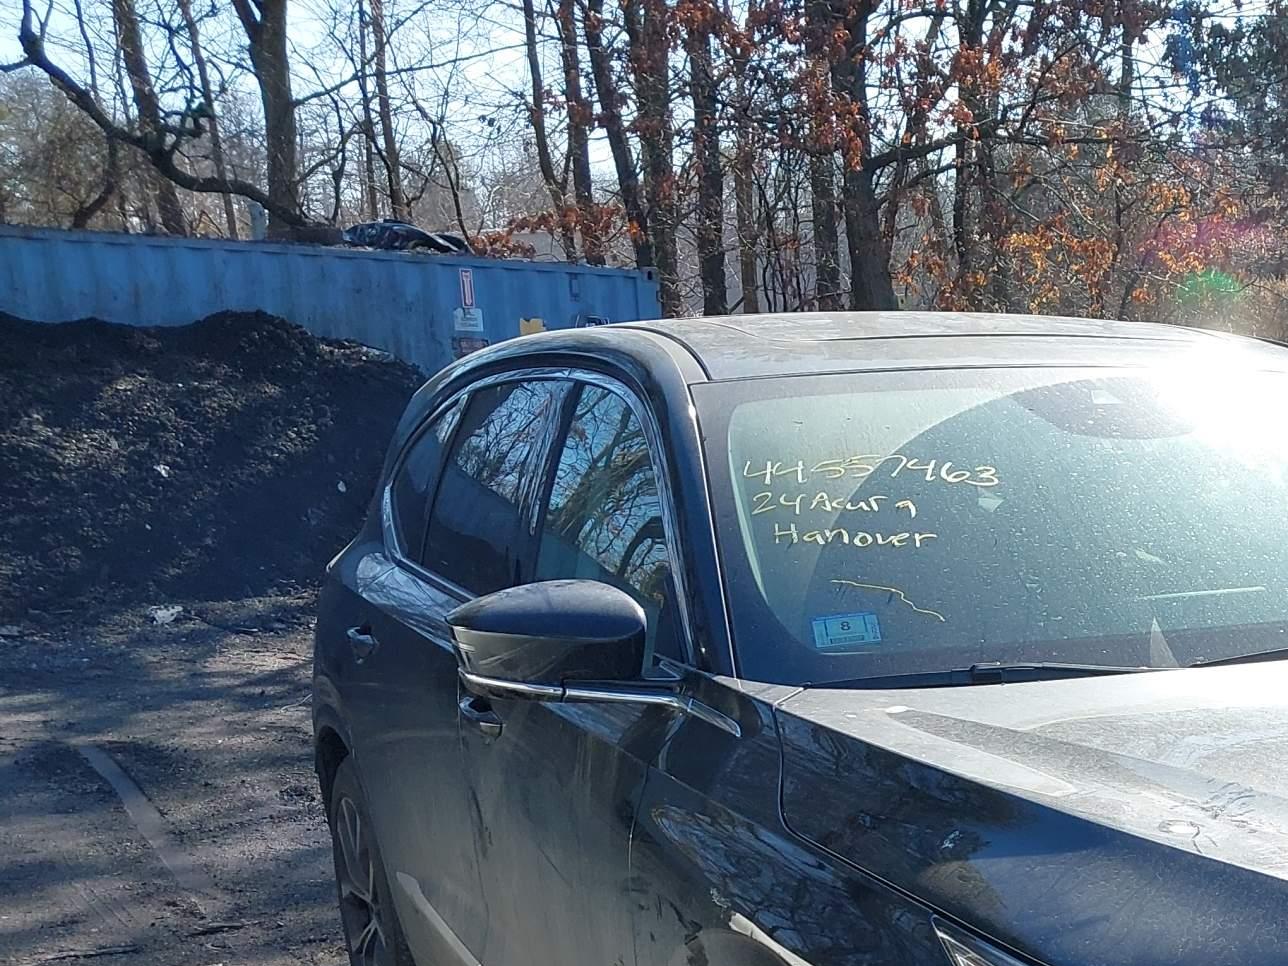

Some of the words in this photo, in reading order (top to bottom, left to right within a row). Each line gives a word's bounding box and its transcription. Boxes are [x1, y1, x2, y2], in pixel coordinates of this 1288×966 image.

[743, 454, 999, 486] 44557463
[752, 491, 806, 515] 24
[773, 523, 938, 549] Hanover
[840, 621, 851, 631] 8
